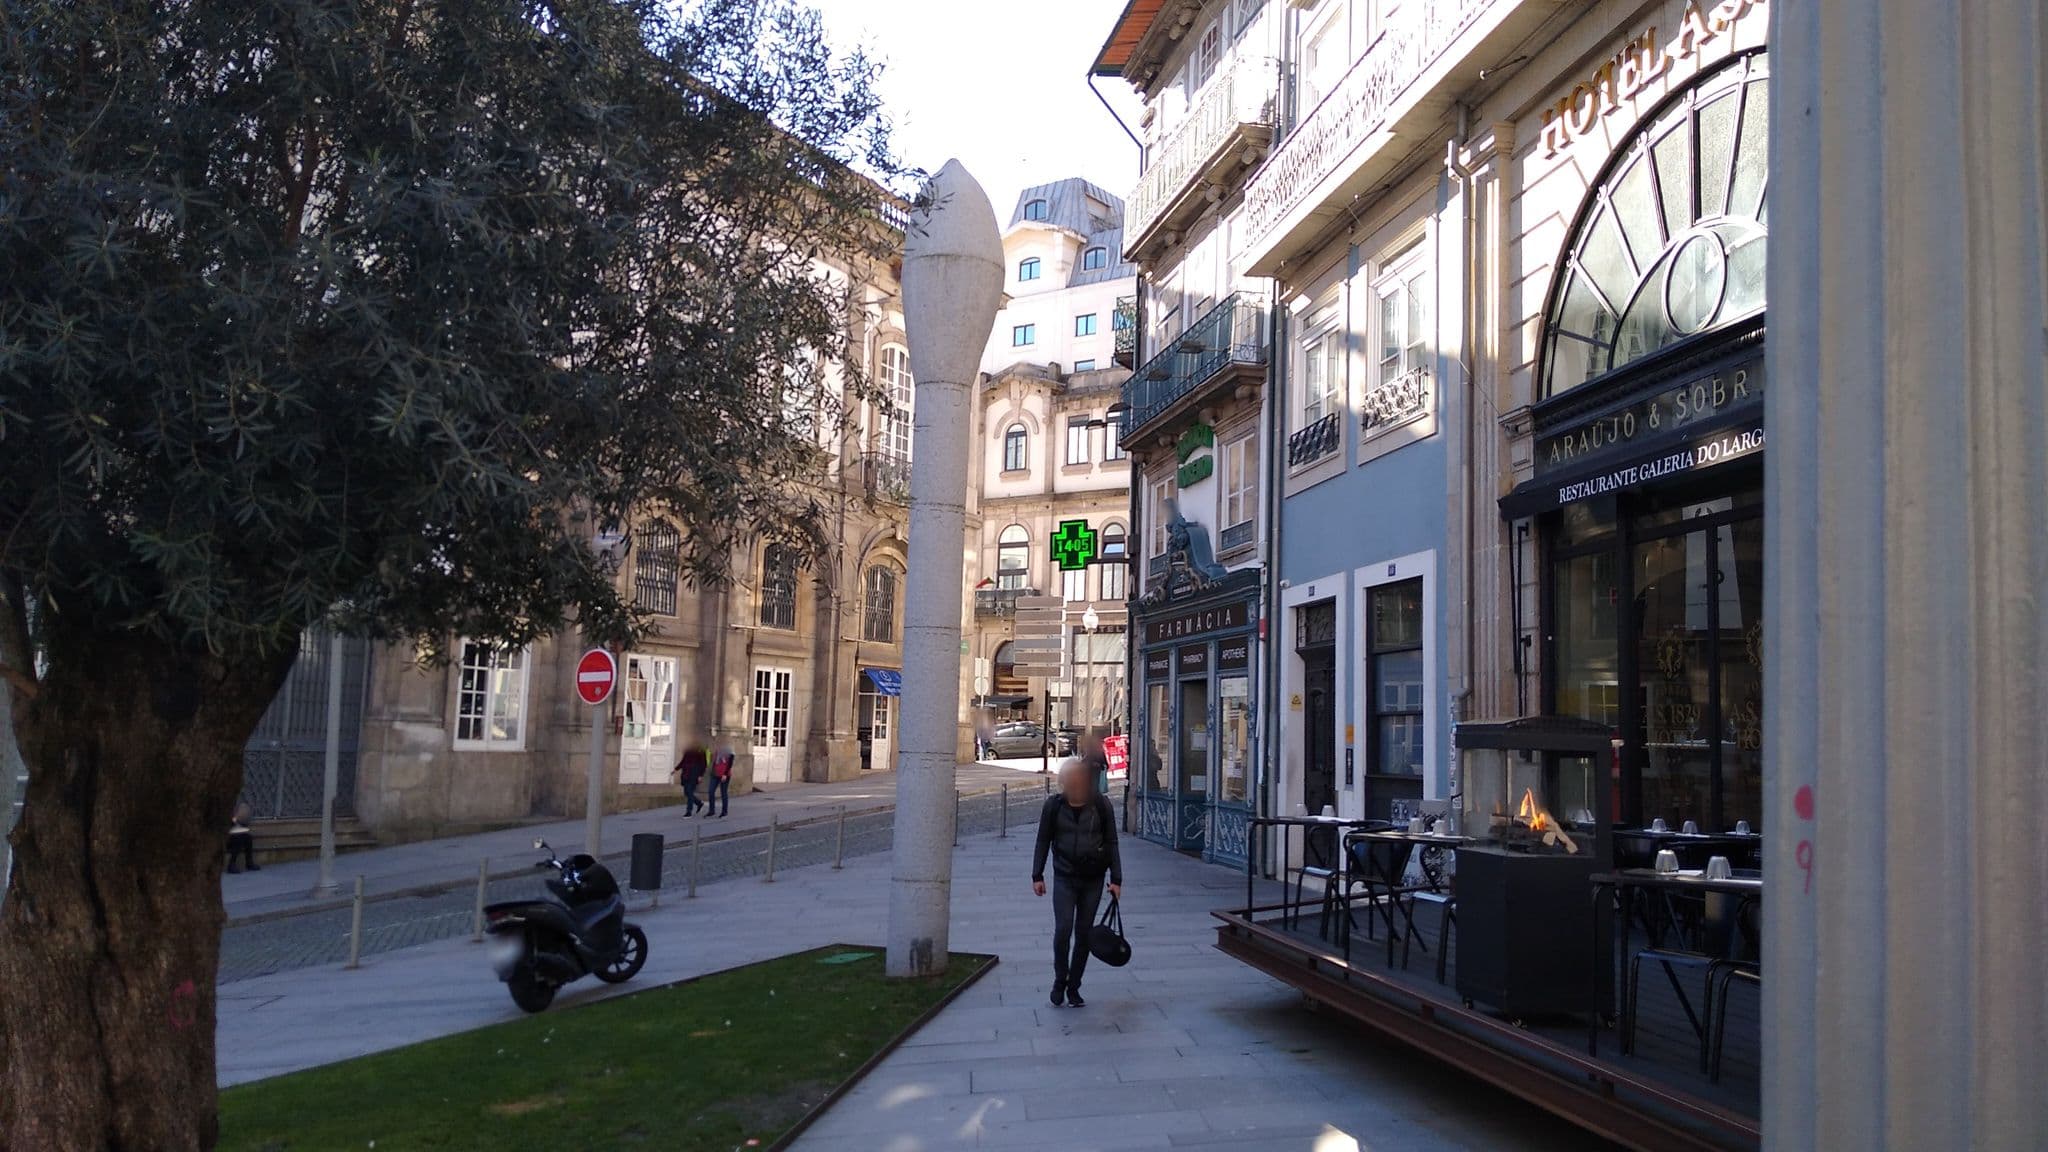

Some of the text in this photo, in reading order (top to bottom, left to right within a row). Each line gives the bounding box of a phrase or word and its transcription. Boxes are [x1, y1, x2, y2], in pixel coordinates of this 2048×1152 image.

[1538, 26, 1671, 160] HOTEL
[1549, 411, 1635, 465] ARAÚJO
[1649, 403, 1661, 429] &
[1558, 467, 1638, 504] RESTAURANTE
[1639, 450, 1695, 482] GALERIA
[1696, 441, 1720, 465] DO
